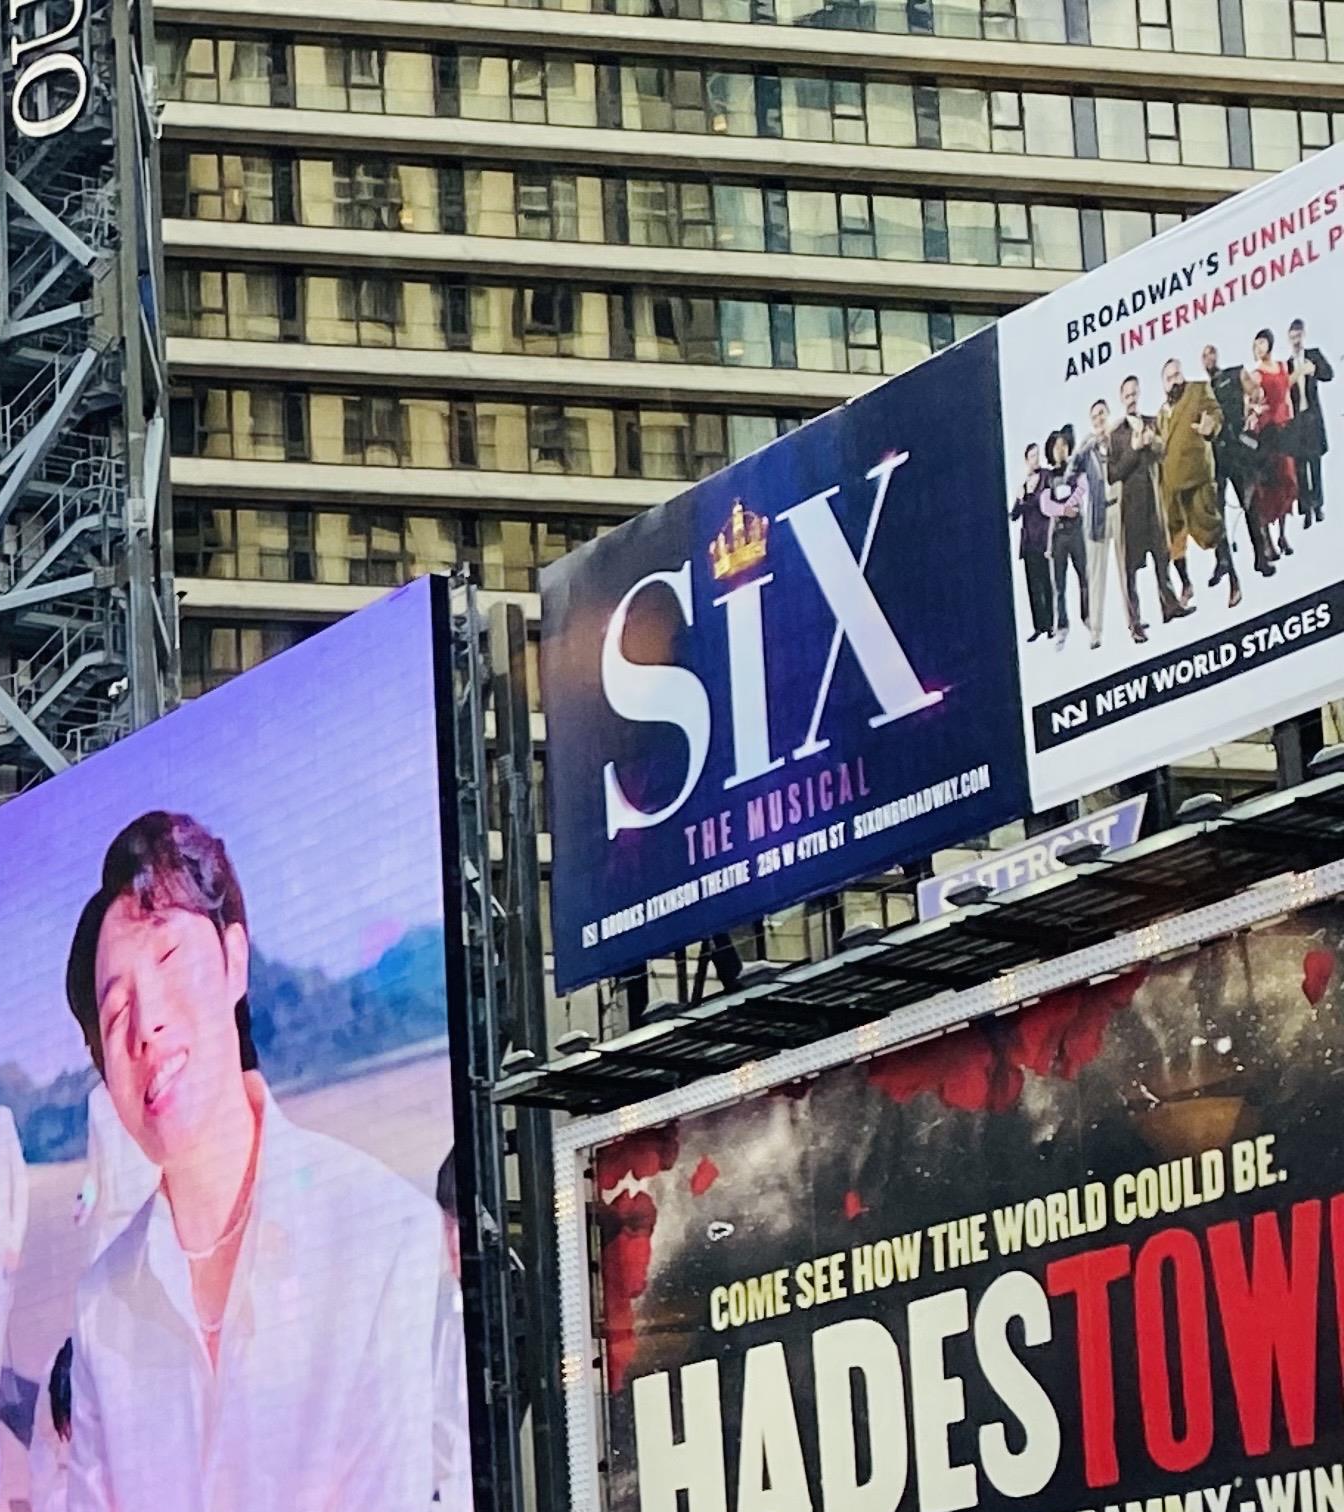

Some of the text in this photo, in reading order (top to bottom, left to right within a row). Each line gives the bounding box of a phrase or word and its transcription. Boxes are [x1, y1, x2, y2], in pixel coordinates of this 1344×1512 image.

[1065, 341, 1113, 381] AND
[1119, 239, 1321, 355] INTERNATIONAL
[1067, 184, 1344, 344] BROADWAY'S FUNNIES
[603, 452, 943, 842] SIX
[1096, 603, 1332, 716] NEW WORLD STAGES
[684, 757, 870, 865] THE MUSICAL
[700, 860, 751, 898] THEATRE
[783, 843, 796, 866] W
[830, 820, 847, 849] ST
[711, 1134, 1287, 1331] COME SEE HOW THE WORLD COULD BE.
